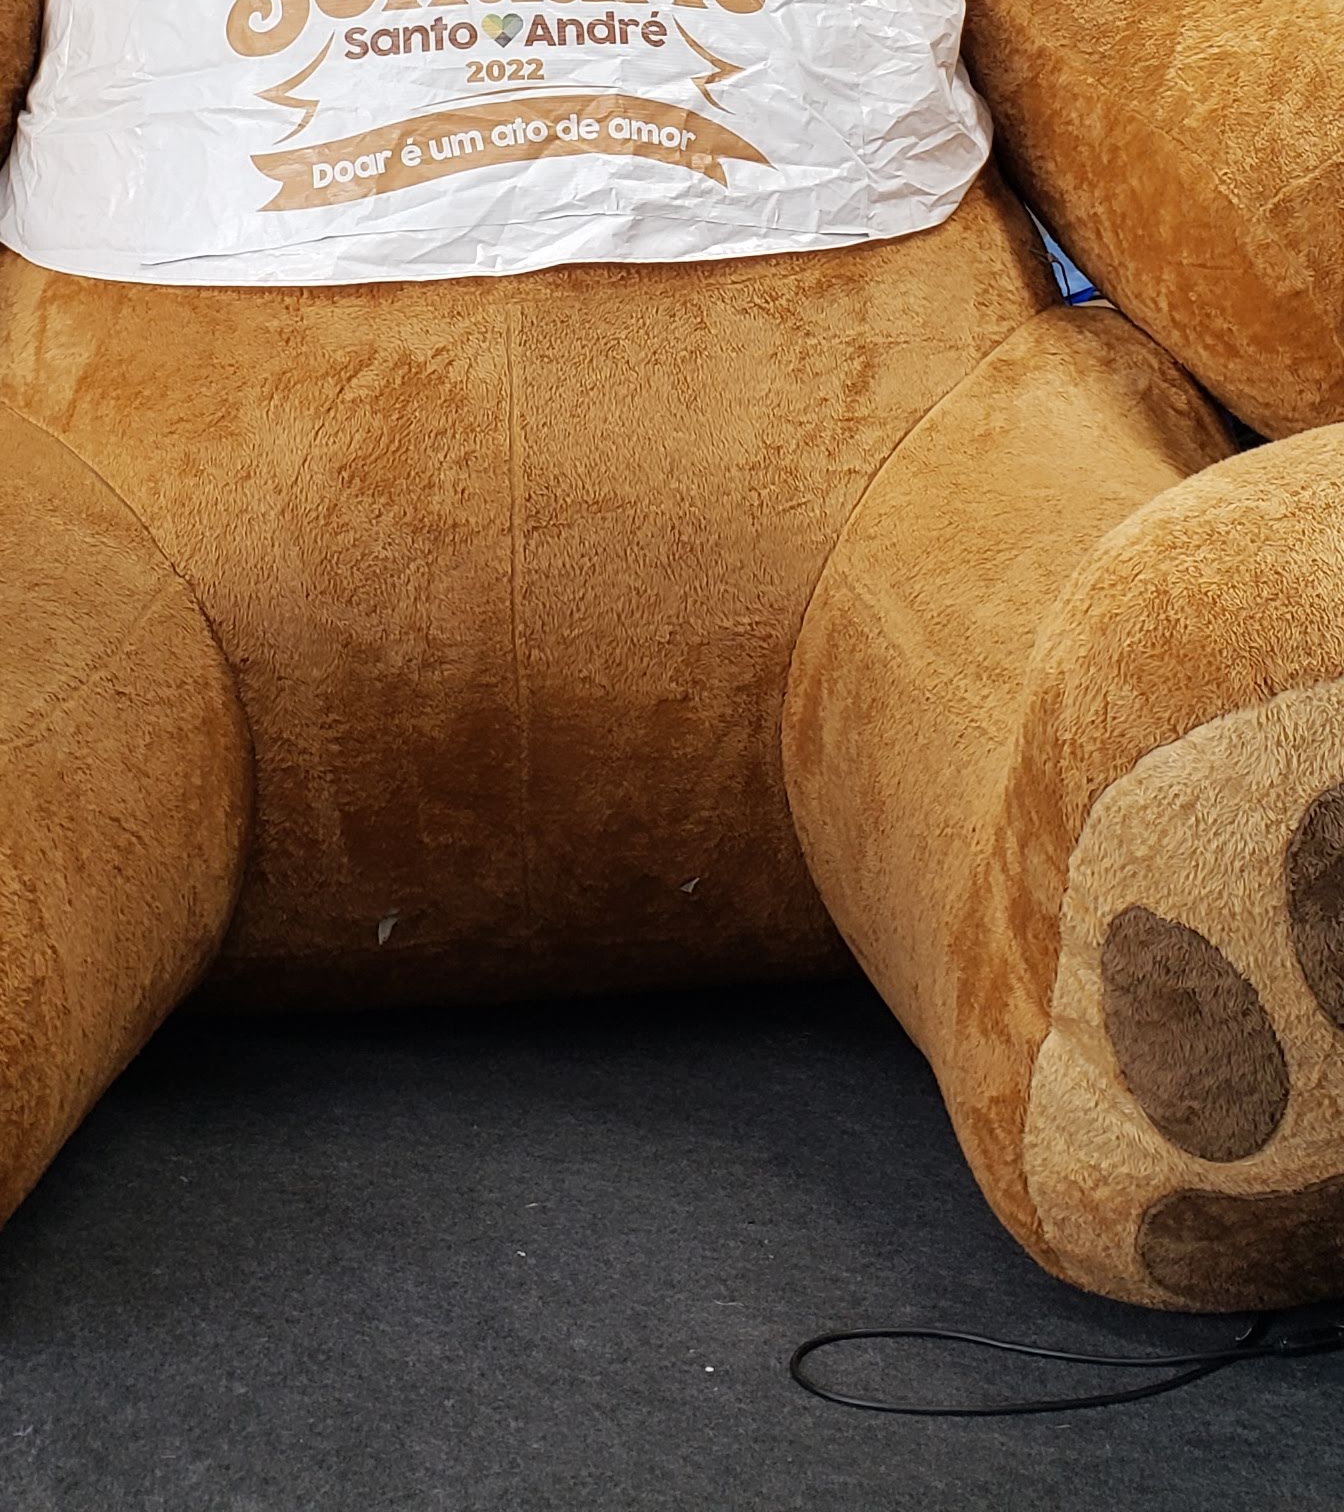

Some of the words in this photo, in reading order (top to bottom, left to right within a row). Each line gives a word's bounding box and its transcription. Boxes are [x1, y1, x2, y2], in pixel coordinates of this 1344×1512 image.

[344, 15, 478, 60] Santo
[524, 10, 668, 48] André
[464, 57, 545, 84] 2022
[311, 146, 393, 190] Doar
[400, 137, 423, 168] é
[428, 127, 484, 161] um
[490, 116, 549, 148] ato
[555, 113, 600, 142] de
[607, 116, 697, 152] amor
